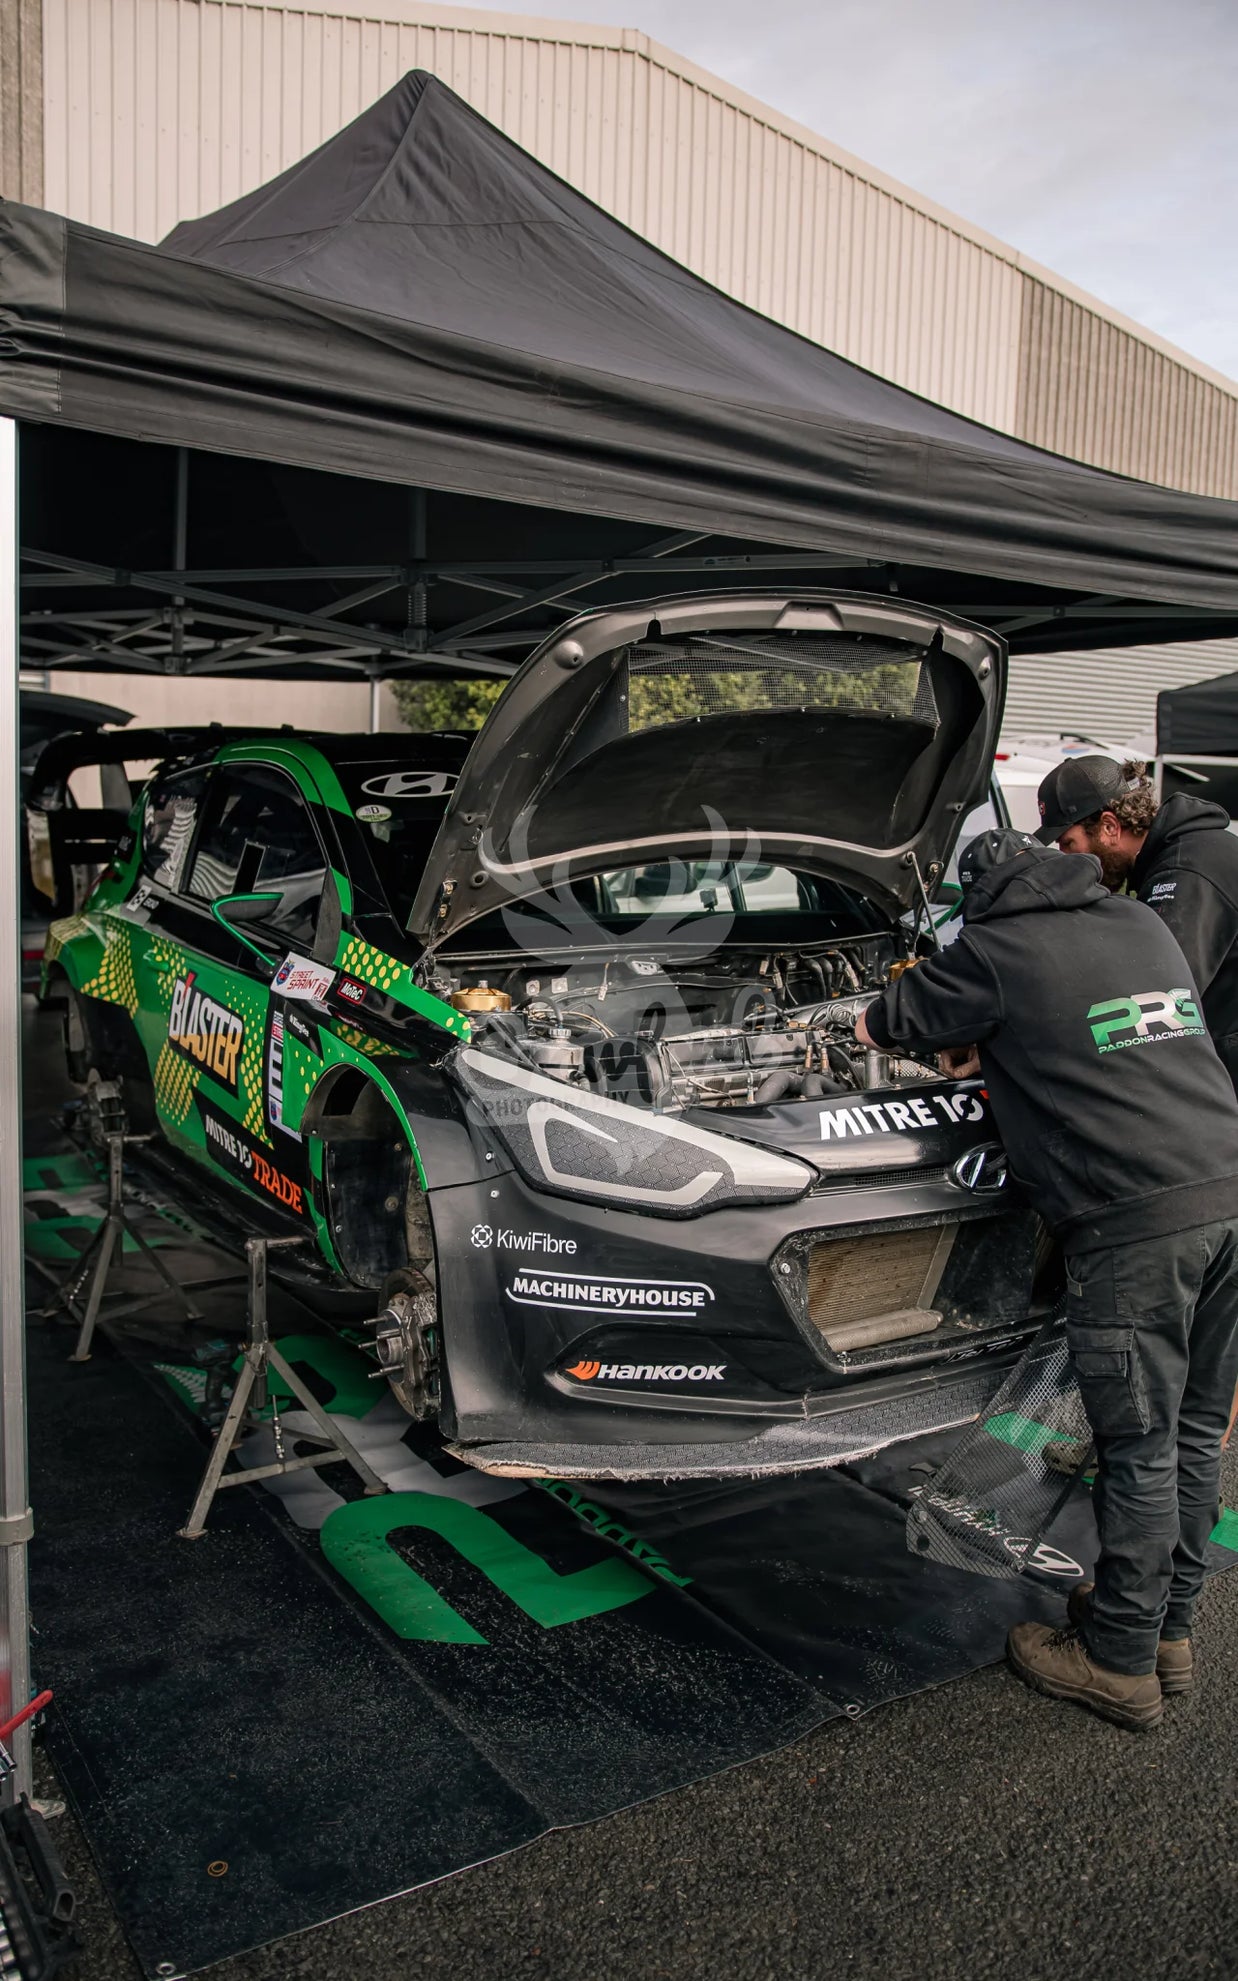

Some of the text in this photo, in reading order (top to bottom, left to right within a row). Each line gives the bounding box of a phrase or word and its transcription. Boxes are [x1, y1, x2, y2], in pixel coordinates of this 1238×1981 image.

[287, 979, 320, 990] SPRINT
[289, 971, 314, 979] STREET
[169, 972, 243, 1085] BLASTER
[1087, 988, 1204, 1047] PRG
[819, 1093, 984, 1140] MITRE 10
[206, 1114, 237, 1158] MITRE
[237, 1139, 252, 1169] 10
[251, 1150, 303, 1214] TRADE
[497, 1229, 577, 1254] KiwiFibre
[513, 1277, 705, 1307] MACHINERYHOUSE
